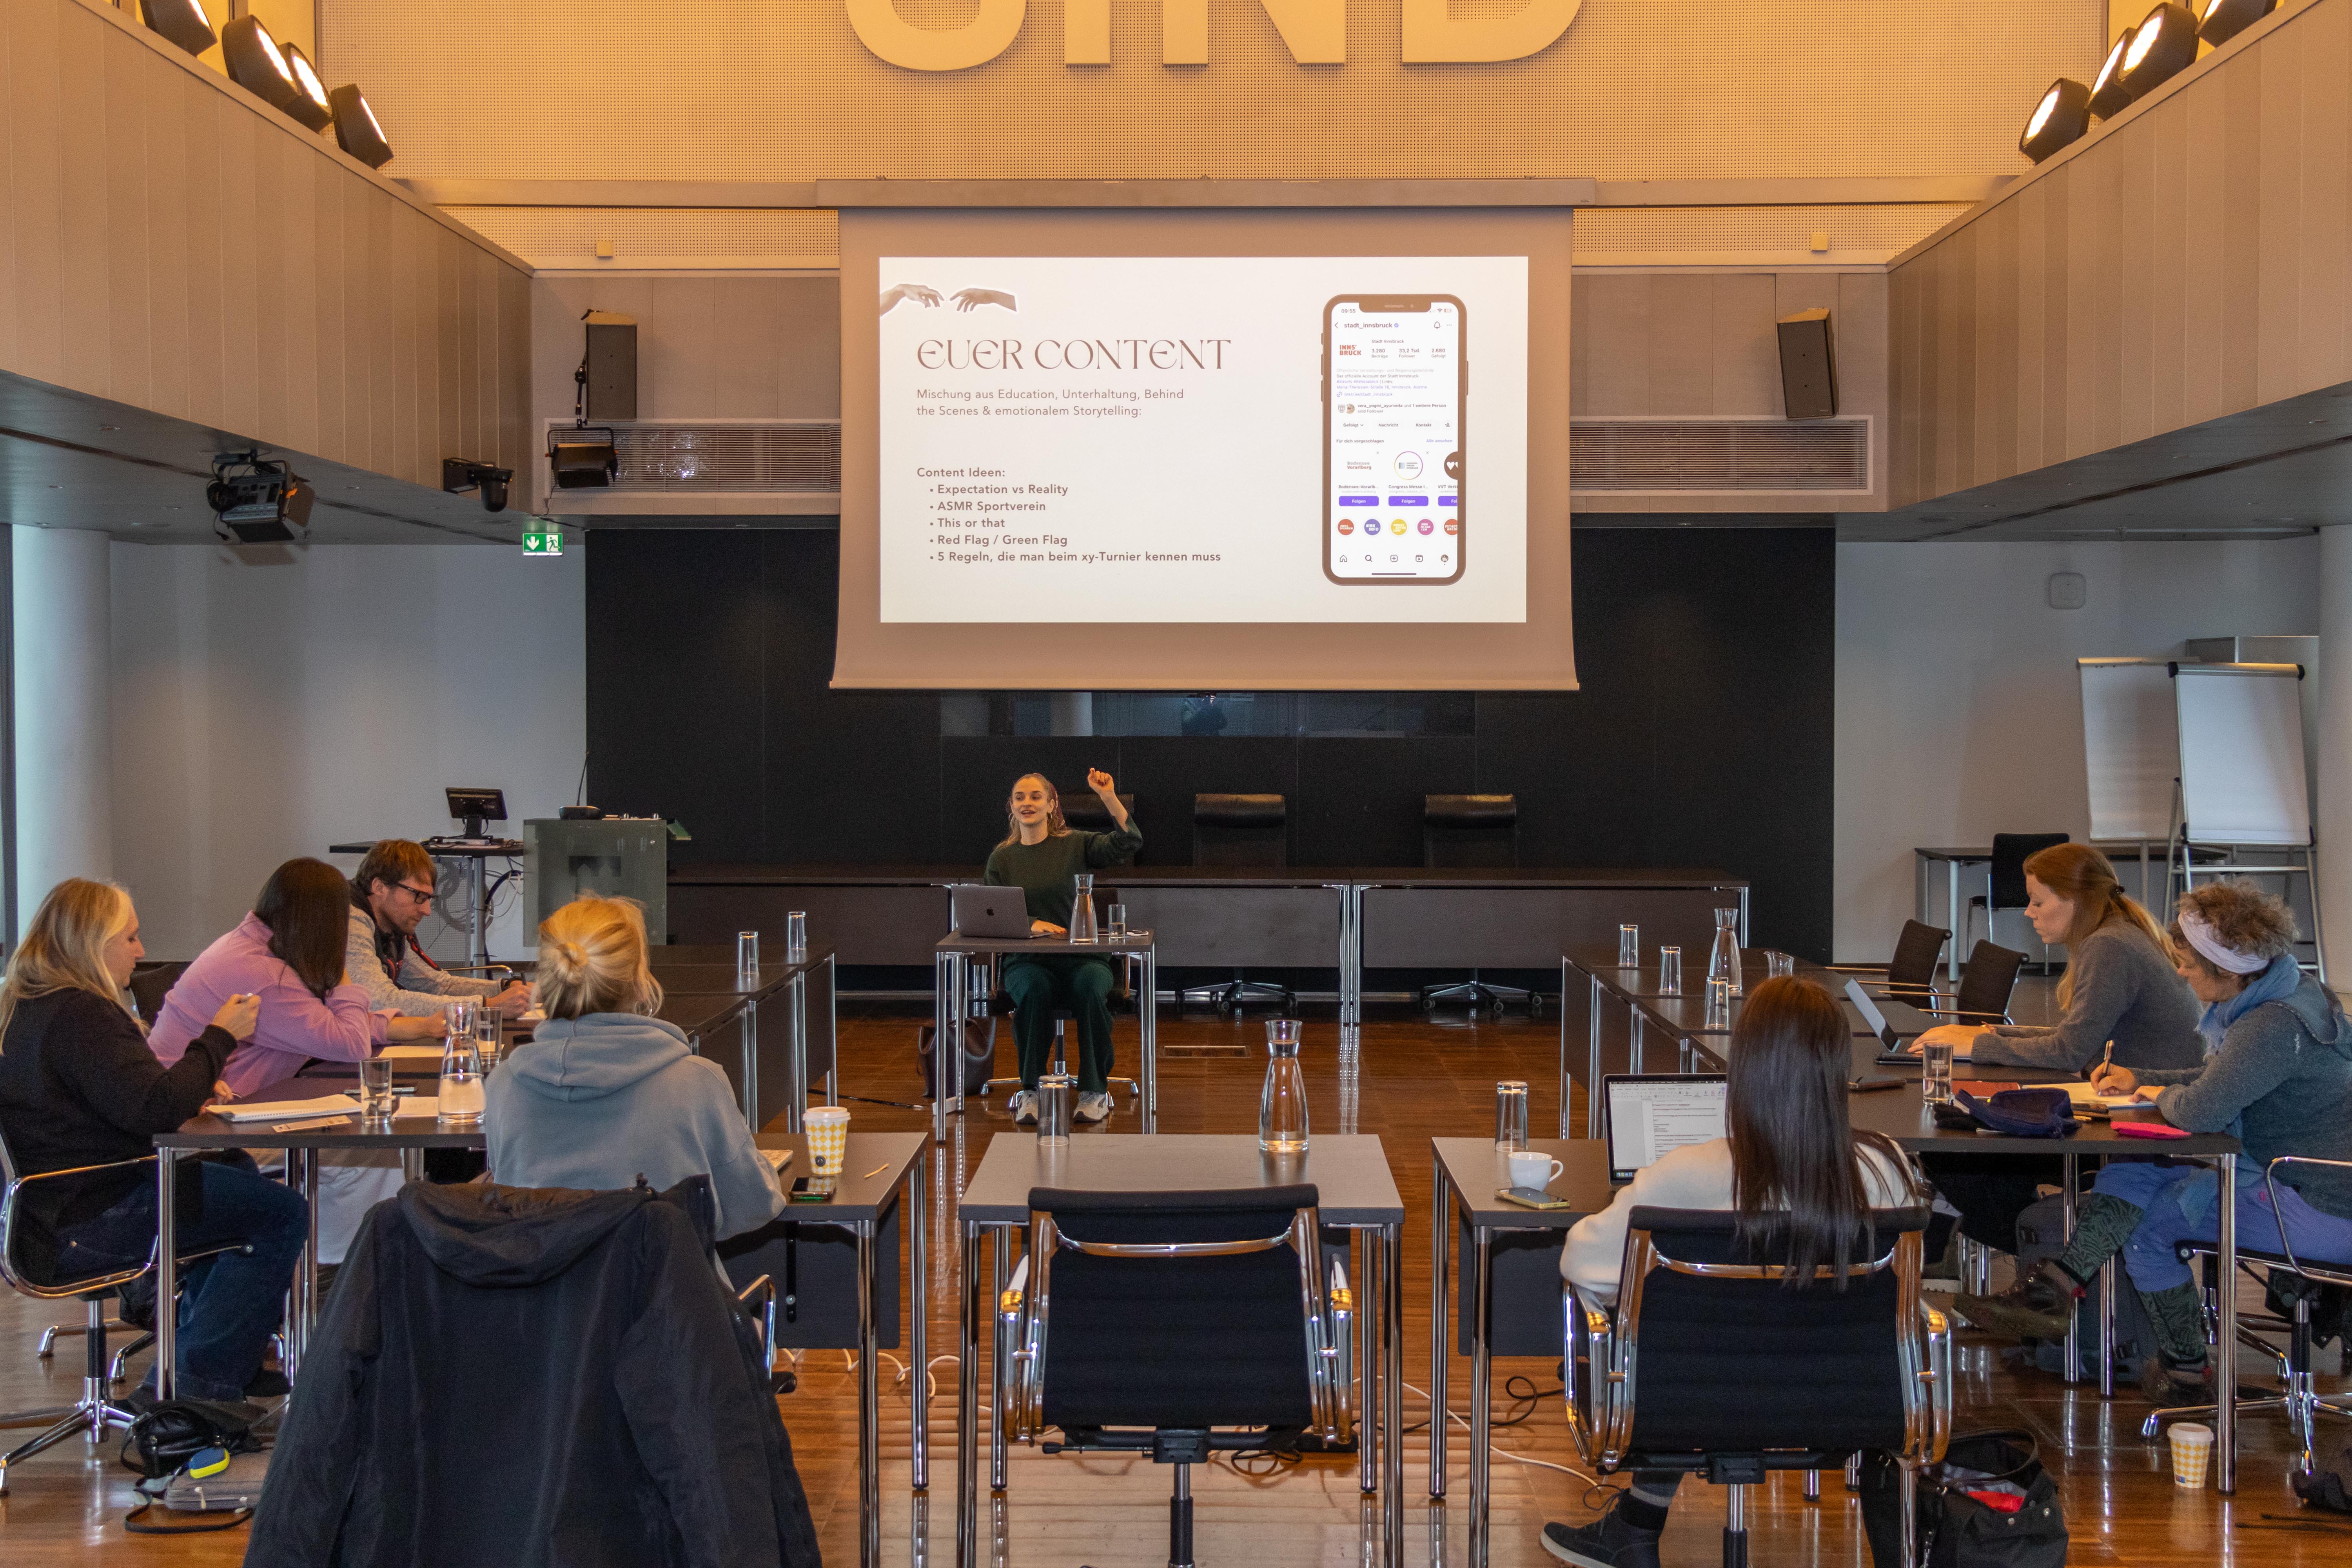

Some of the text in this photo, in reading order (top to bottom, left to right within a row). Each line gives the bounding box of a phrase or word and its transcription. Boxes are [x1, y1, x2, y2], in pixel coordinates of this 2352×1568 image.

[917, 339, 1231, 370] EUER CONTENT
[917, 388, 971, 401] Mischung
[998, 388, 1058, 400] Education,
[1062, 388, 1140, 402] Unterhaltung,
[1145, 388, 1183, 399] Behind
[916, 405, 1142, 418] the Scenes & emotionalem Storytelling:
[916, 467, 1005, 477] Content Ideen:
[938, 484, 1008, 497] Expectation
[1028, 483, 1068, 497] Reality
[937, 501, 1046, 513] ASMR Sportverein
[937, 517, 961, 528] This
[981, 517, 1005, 528] that
[938, 534, 1067, 547] Red Flag / Green Flag
[938, 552, 944, 561] 5
[949, 551, 993, 564] Regeln,
[997, 551, 1016, 561] die
[1049, 551, 1077, 561] beim
[1082, 552, 1141, 564] xy-Turnier
[1145, 551, 1187, 561] kennen
